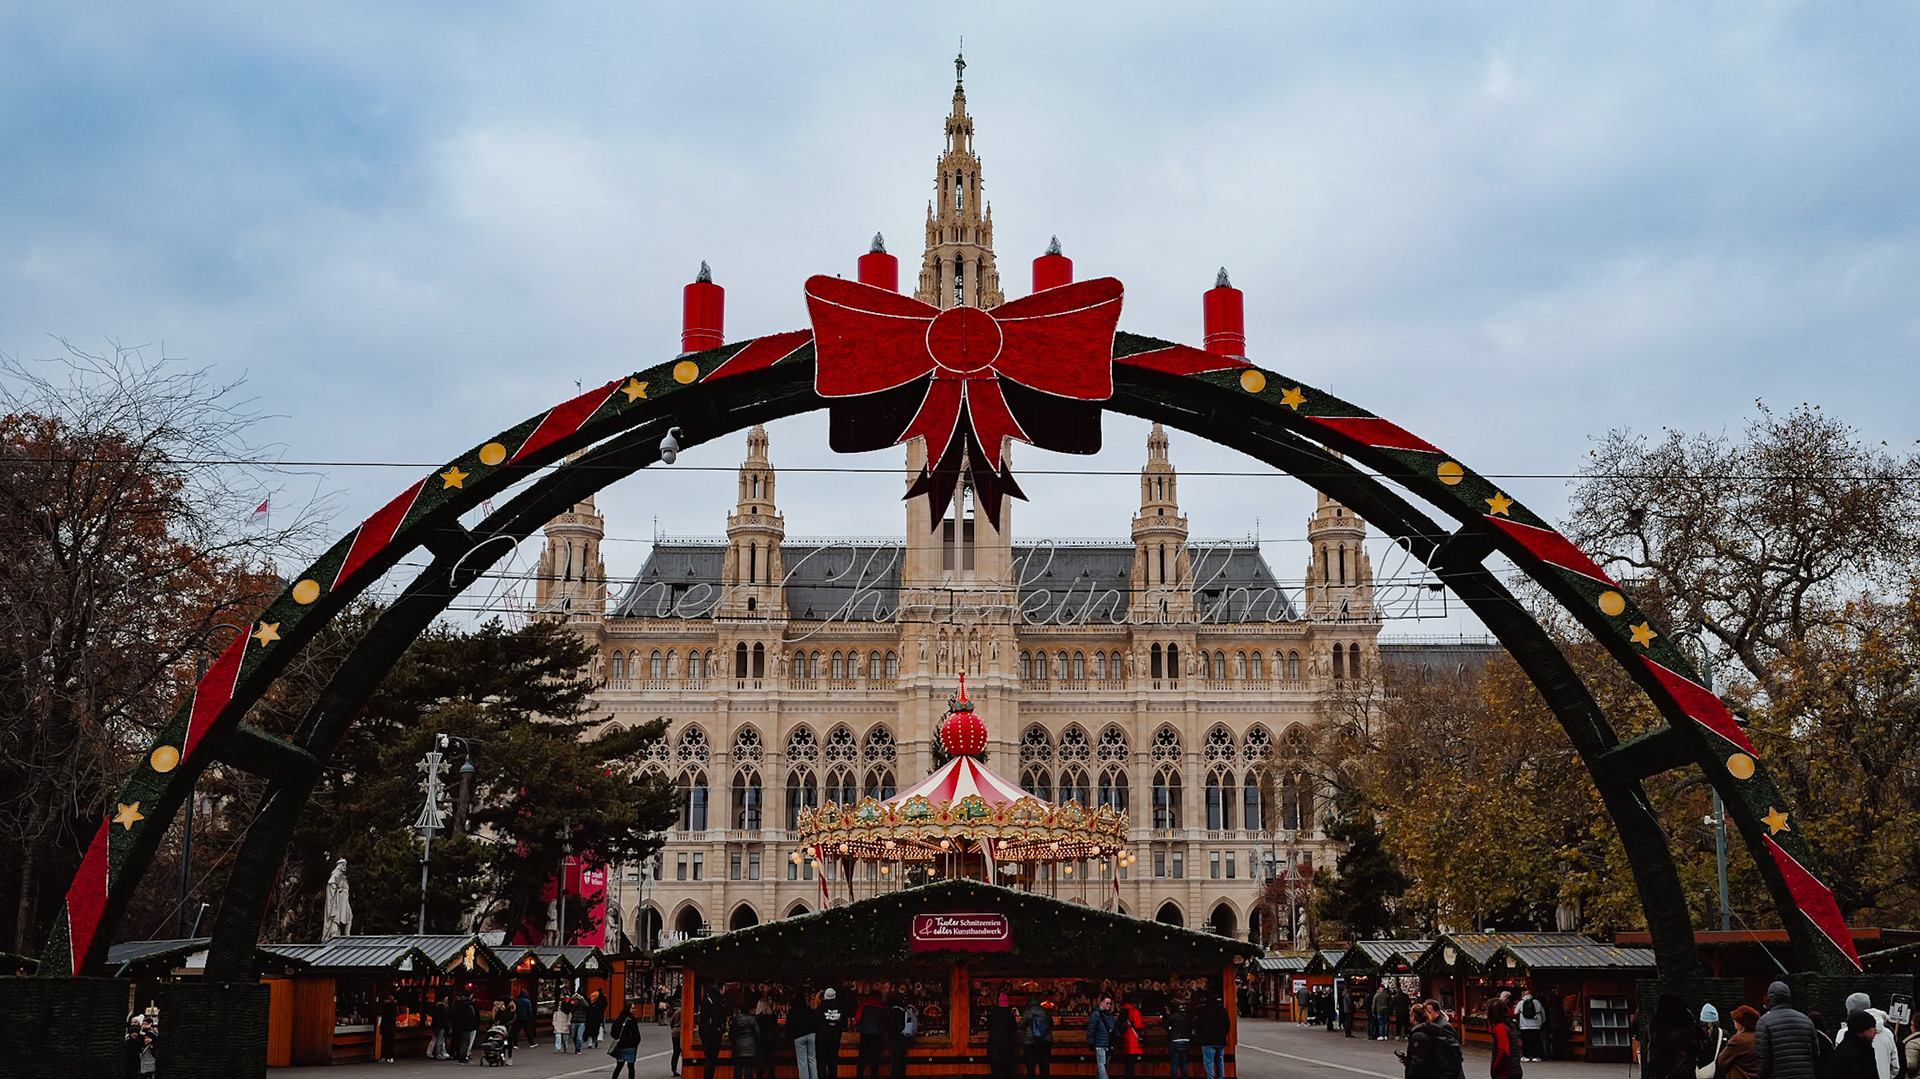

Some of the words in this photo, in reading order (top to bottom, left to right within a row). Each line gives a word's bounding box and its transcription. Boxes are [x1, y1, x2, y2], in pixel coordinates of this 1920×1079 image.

[450, 534, 750, 620] Wiener
[767, 534, 1444, 643] Christkindlmarkt
[933, 926, 952, 935] edles
